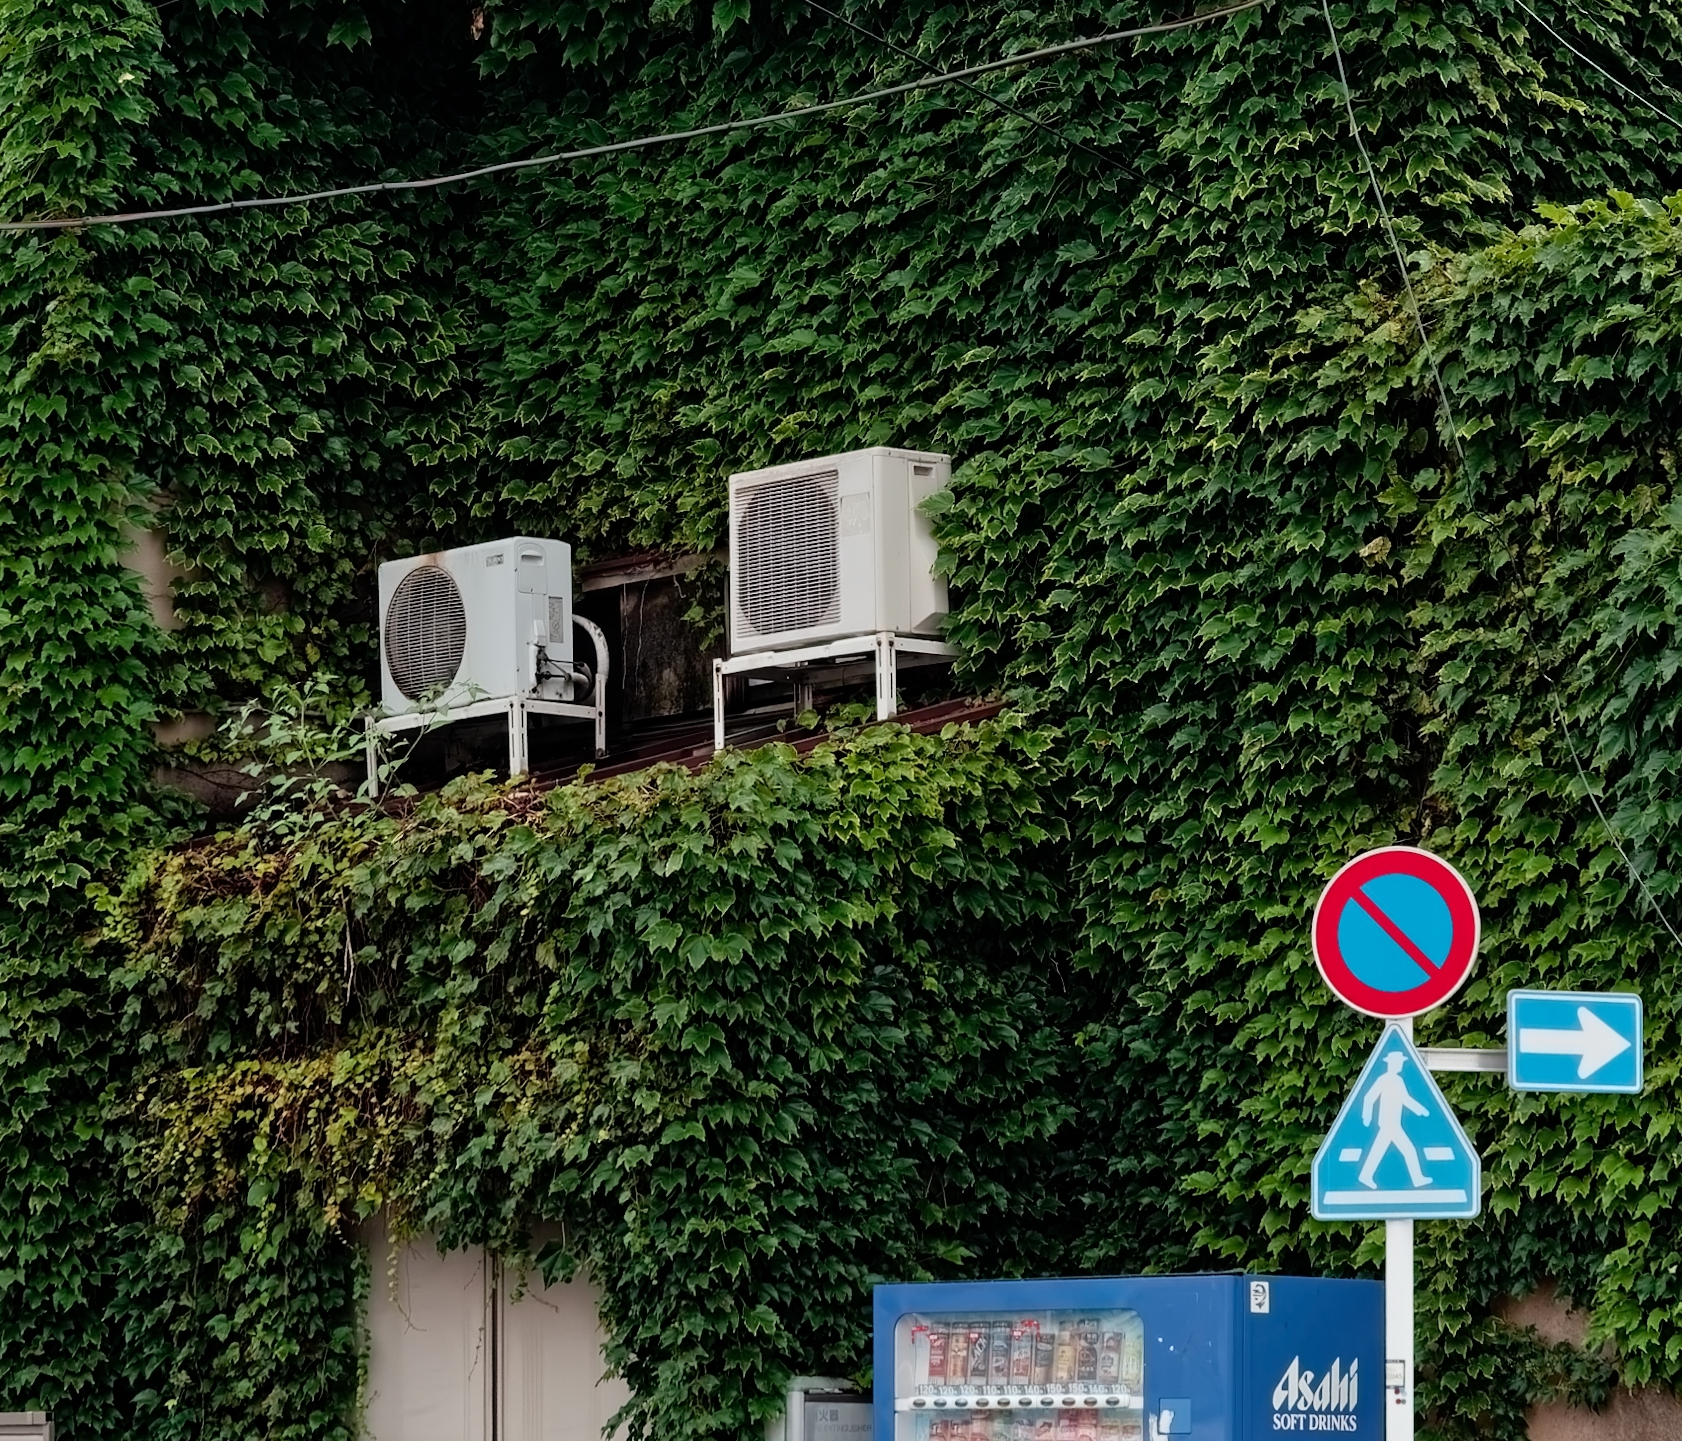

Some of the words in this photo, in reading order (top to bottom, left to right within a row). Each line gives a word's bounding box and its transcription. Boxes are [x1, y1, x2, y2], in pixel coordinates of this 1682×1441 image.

[1273, 1355, 1358, 1412] Asahi
[1273, 1413, 1306, 1431] SOFT
[1309, 1414, 1357, 1432] DRINKS
